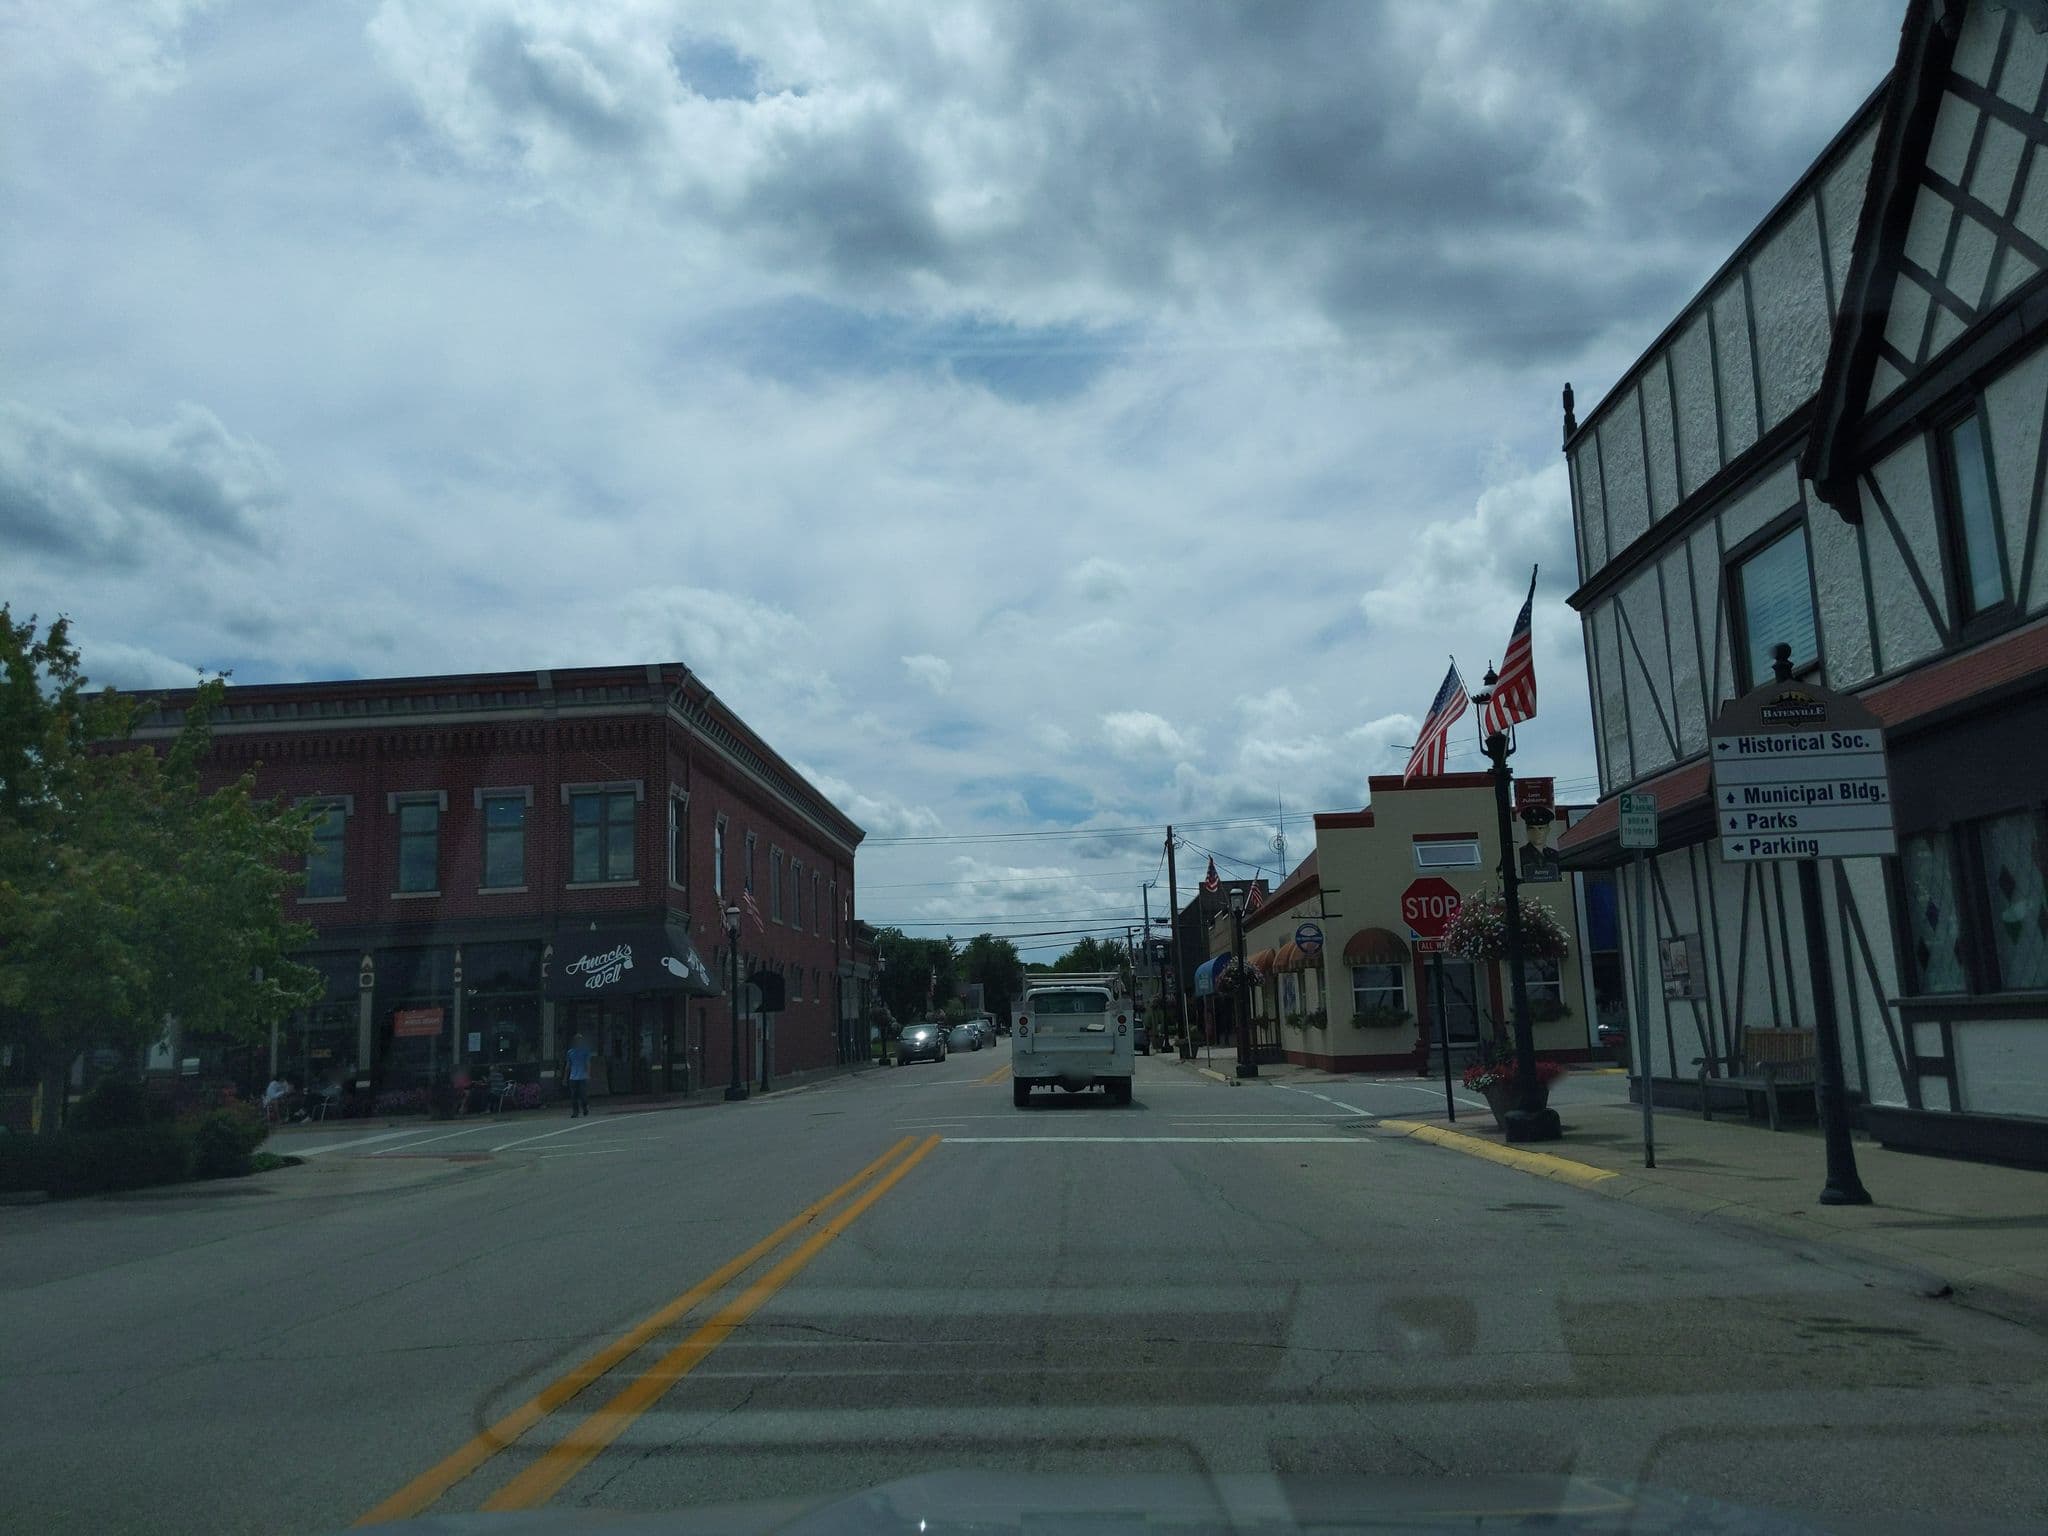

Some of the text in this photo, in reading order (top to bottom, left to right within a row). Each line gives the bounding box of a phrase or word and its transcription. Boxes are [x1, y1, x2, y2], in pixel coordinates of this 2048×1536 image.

[1763, 706, 1825, 719] BATESVILLE
[1738, 732, 1870, 754] Historical Soc.
[1744, 782, 1886, 806] Municipal Bldg.
[1622, 797, 1630, 810] 2
[1747, 812, 1798, 829] Parks
[1750, 837, 1819, 856] Parking
[1406, 895, 1458, 920] STOP
[1420, 941, 1434, 951] ALL
